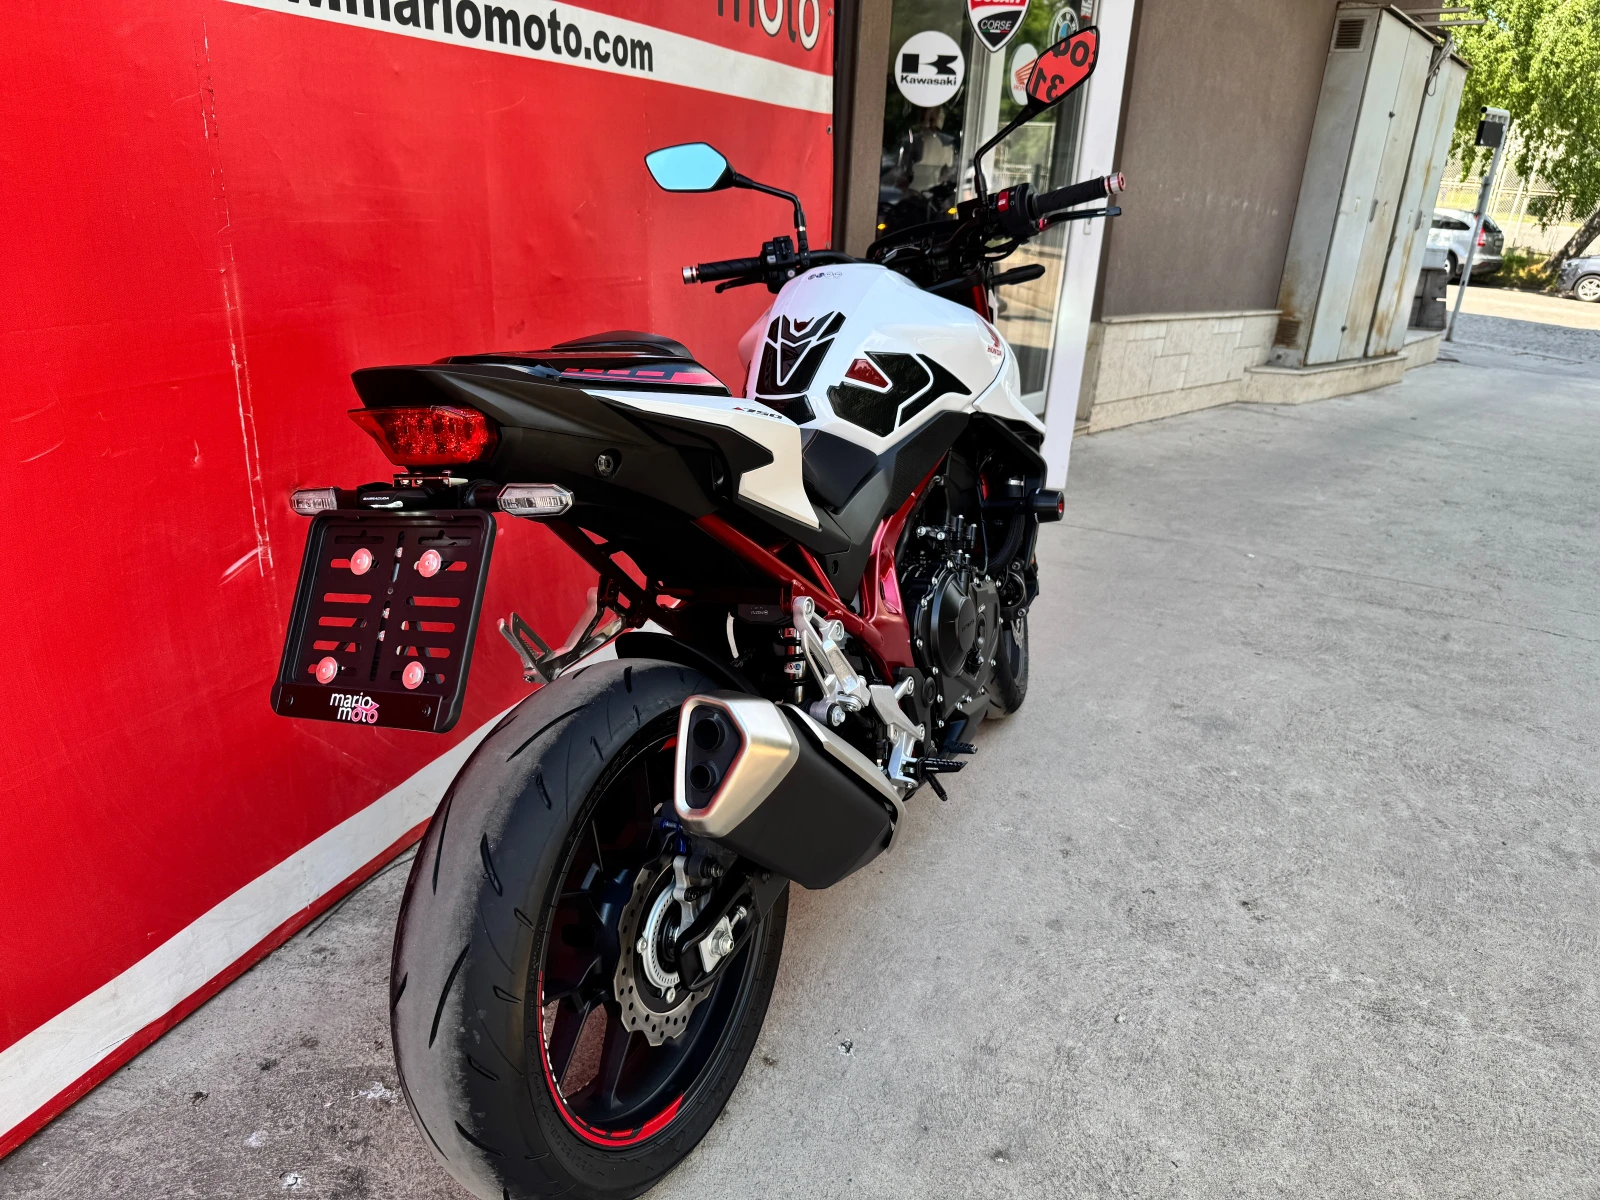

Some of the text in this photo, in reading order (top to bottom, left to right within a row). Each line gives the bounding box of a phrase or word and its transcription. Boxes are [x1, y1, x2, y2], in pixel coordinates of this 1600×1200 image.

[980, 20, 1012, 30] CORSE
[288, 0, 653, 72] .ariomoto.com
[900, 75, 957, 86] Kawasaki
[329, 692, 372, 709] mario
[337, 706, 379, 724] moto
